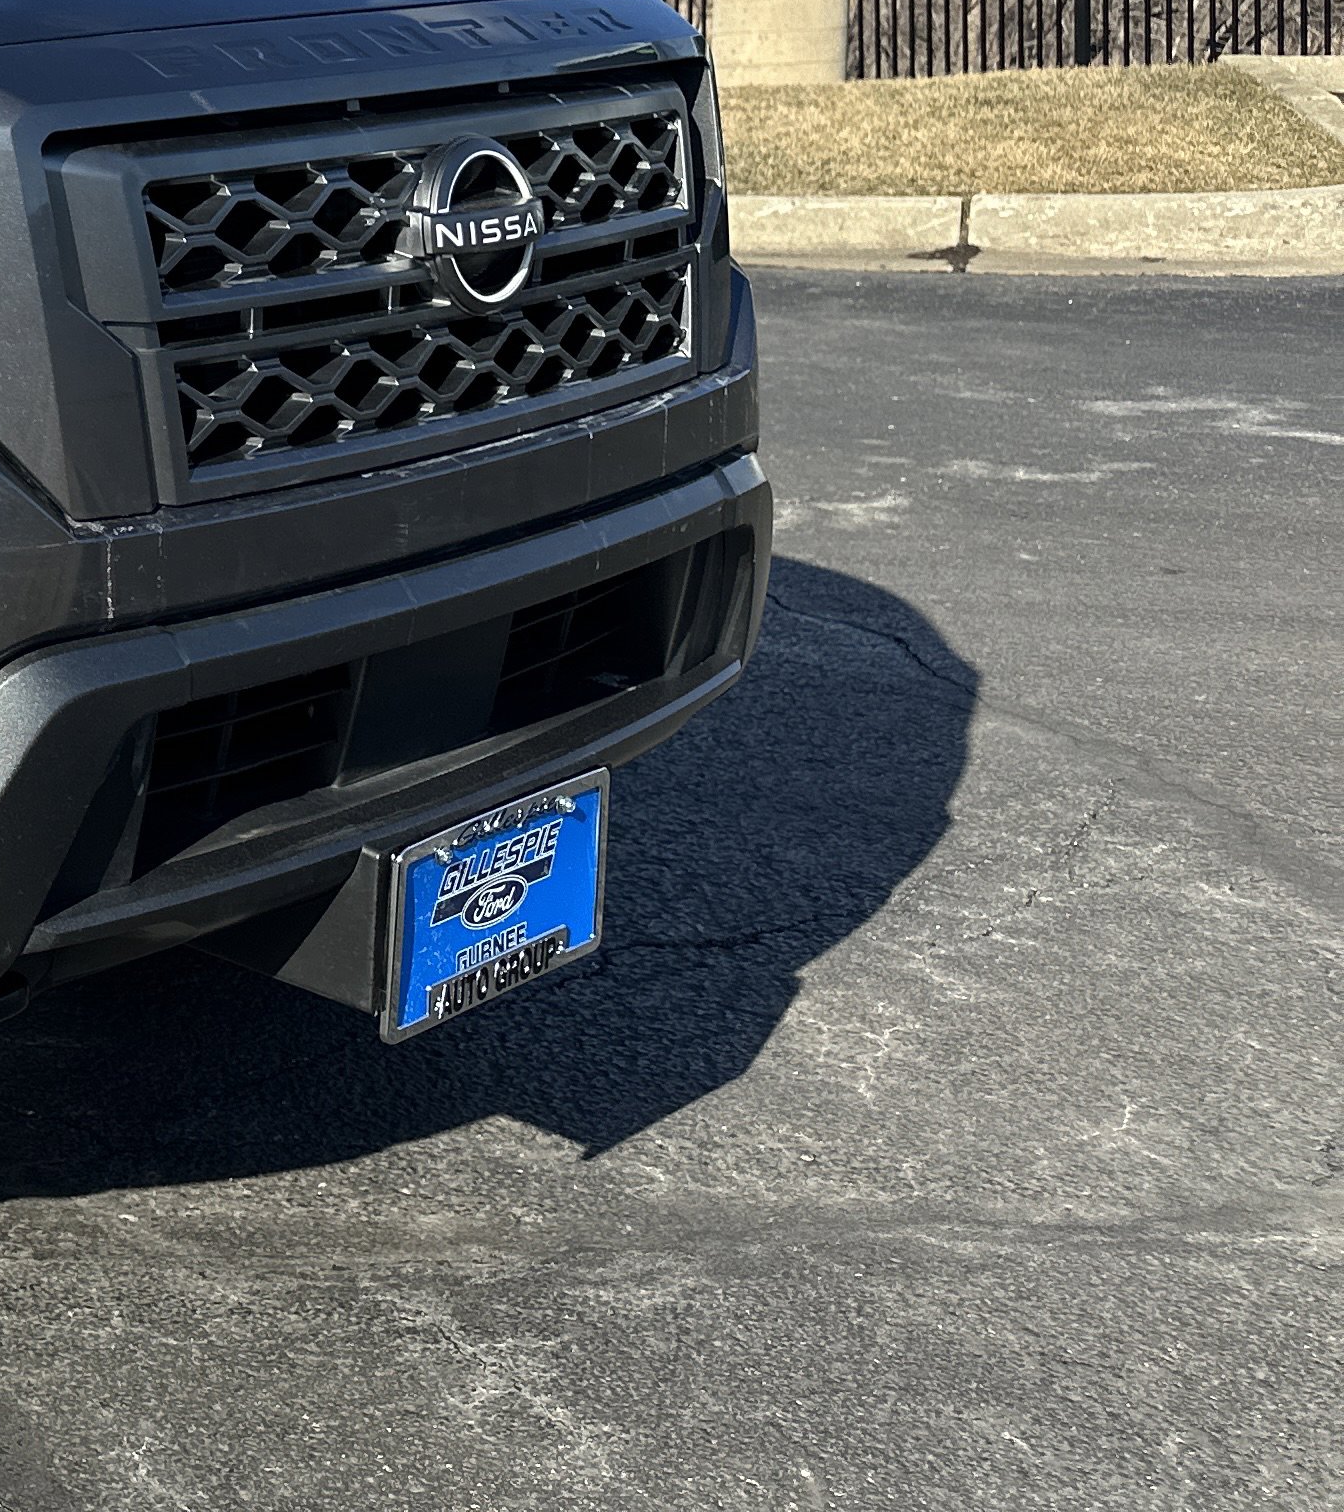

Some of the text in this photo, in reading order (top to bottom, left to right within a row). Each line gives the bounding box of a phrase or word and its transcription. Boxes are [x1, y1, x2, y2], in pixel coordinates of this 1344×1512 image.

[132, 6, 633, 79] FRONTIER
[435, 211, 539, 249] NISSA
[438, 818, 563, 899] GILLESPIE
[473, 884, 516, 922] Ford
[434, 936, 557, 1020] AUTO GROUP
